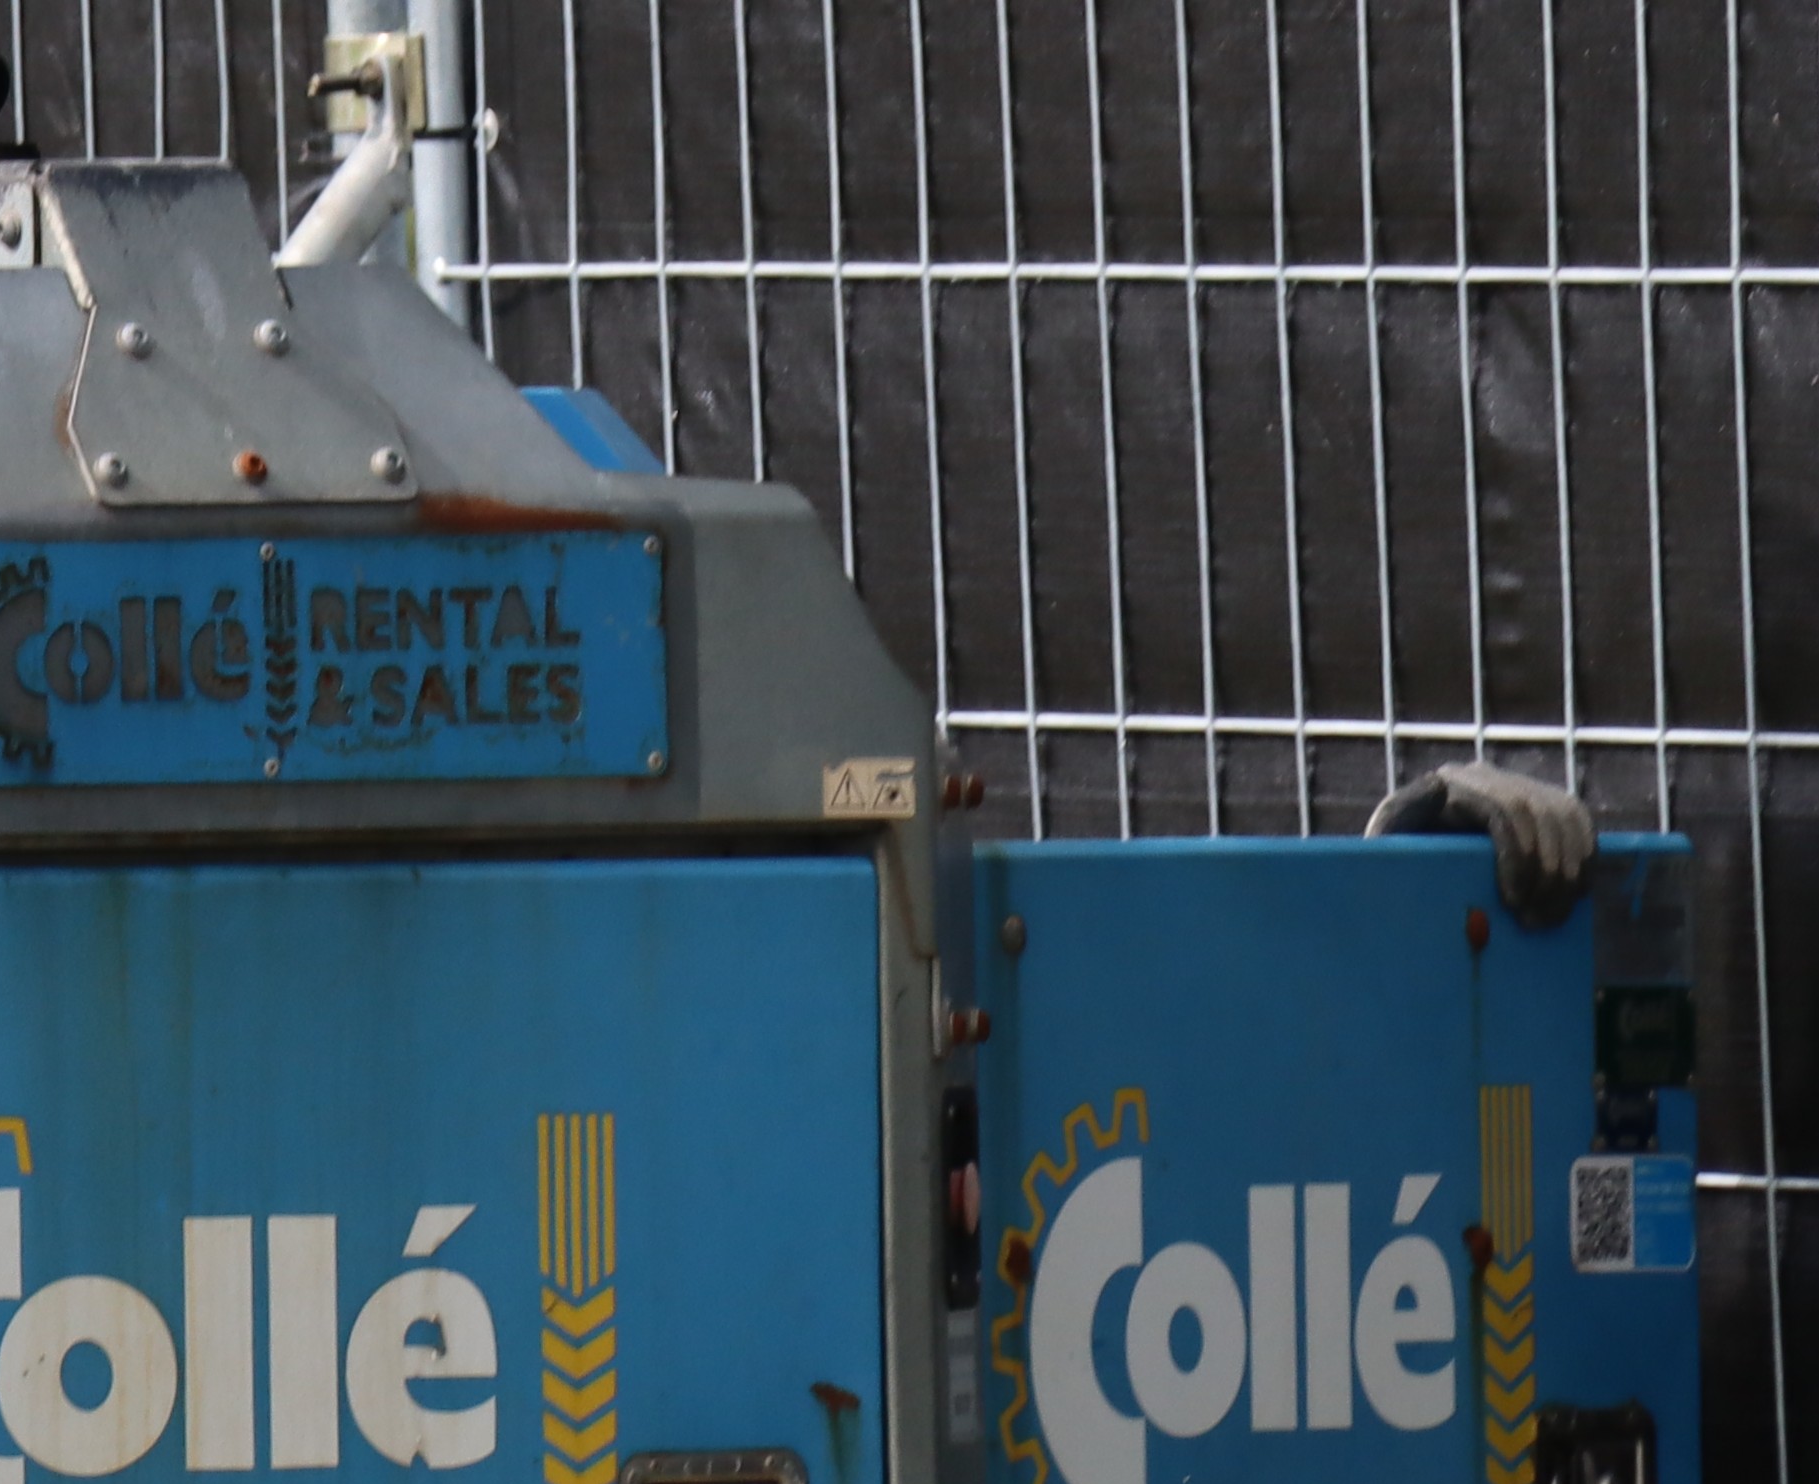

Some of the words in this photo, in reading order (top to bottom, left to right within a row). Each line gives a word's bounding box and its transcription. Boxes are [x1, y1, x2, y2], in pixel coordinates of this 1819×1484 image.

[309, 583, 581, 652] RENTAL
[306, 663, 356, 728] &
[367, 661, 581, 727] SALES
